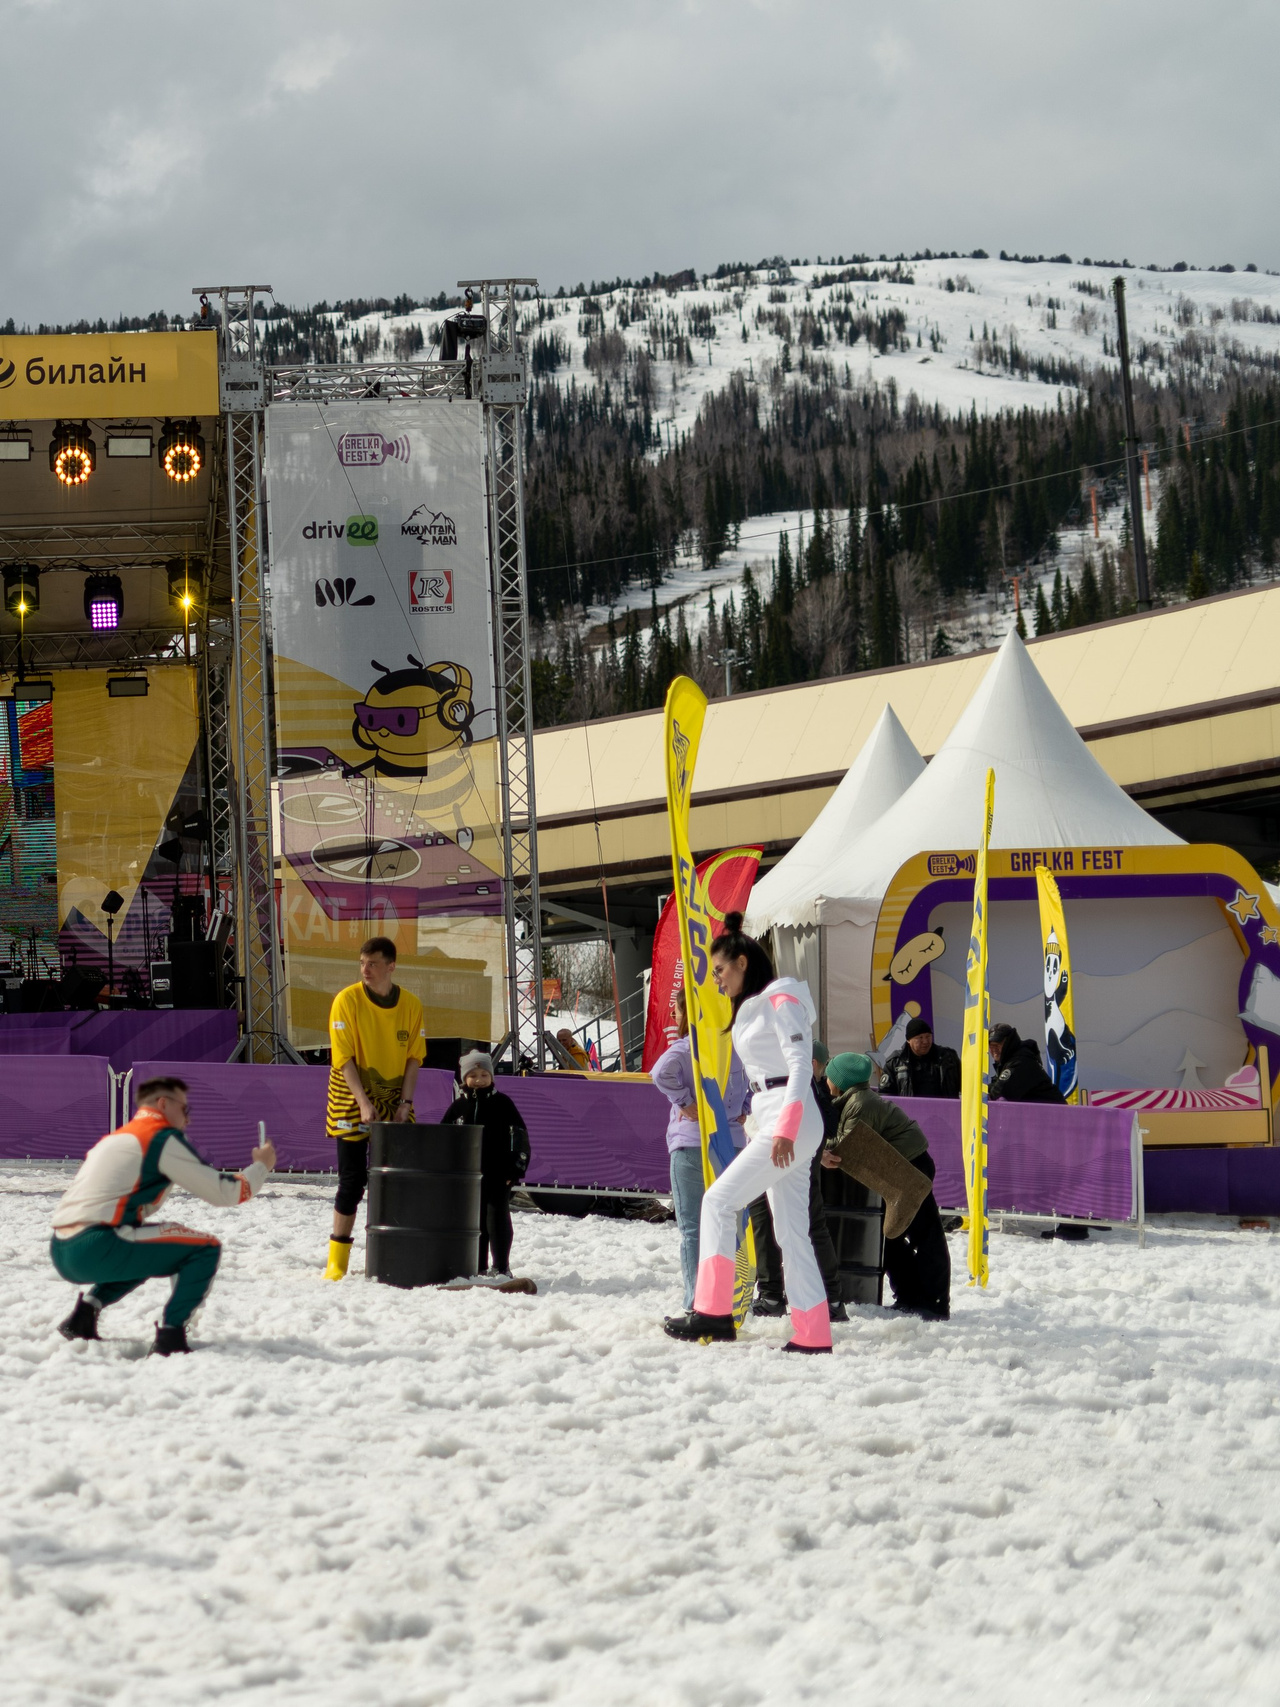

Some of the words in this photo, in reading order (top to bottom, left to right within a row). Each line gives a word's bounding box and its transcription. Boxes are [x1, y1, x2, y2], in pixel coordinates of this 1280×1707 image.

[25, 356, 147, 386] билайн
[344, 438, 380, 449] GRELKA
[345, 451, 369, 462] FEST
[302, 520, 378, 541] drivee
[401, 525, 455, 535] MOUNTAIN
[432, 536, 457, 545] MAN
[411, 605, 453, 613] ROSTIC'S
[932, 857, 955, 865] GRELKA
[1011, 851, 1073, 871] GRELKA
[1082, 850, 1124, 870] FEST
[932, 865, 948, 873] FEST
[668, 989, 679, 1008] SUN
